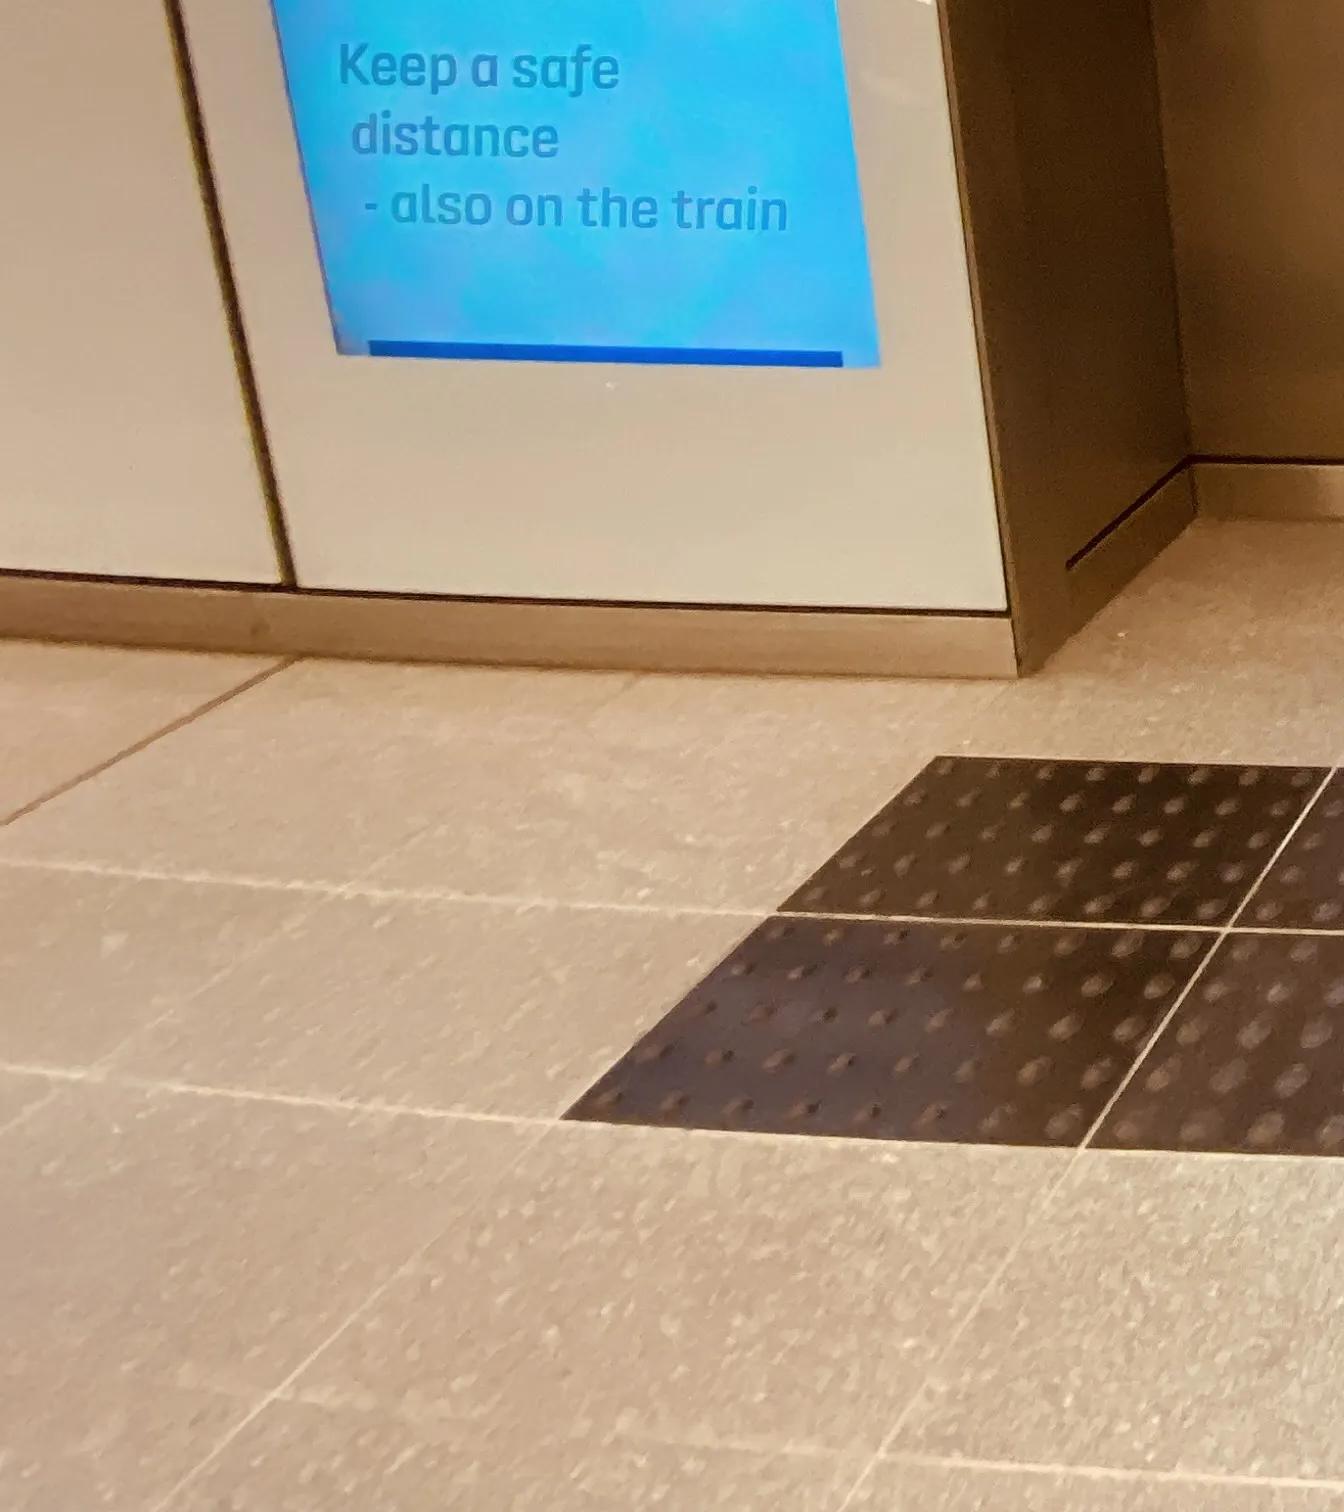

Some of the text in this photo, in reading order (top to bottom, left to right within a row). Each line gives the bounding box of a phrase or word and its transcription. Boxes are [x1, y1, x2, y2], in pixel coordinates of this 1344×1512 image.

[339, 42, 619, 98] Keep a safe
[350, 109, 559, 158] distance
[390, 183, 492, 226] also
[505, 193, 564, 227] on
[576, 186, 658, 229] the
[671, 185, 787, 232] train
